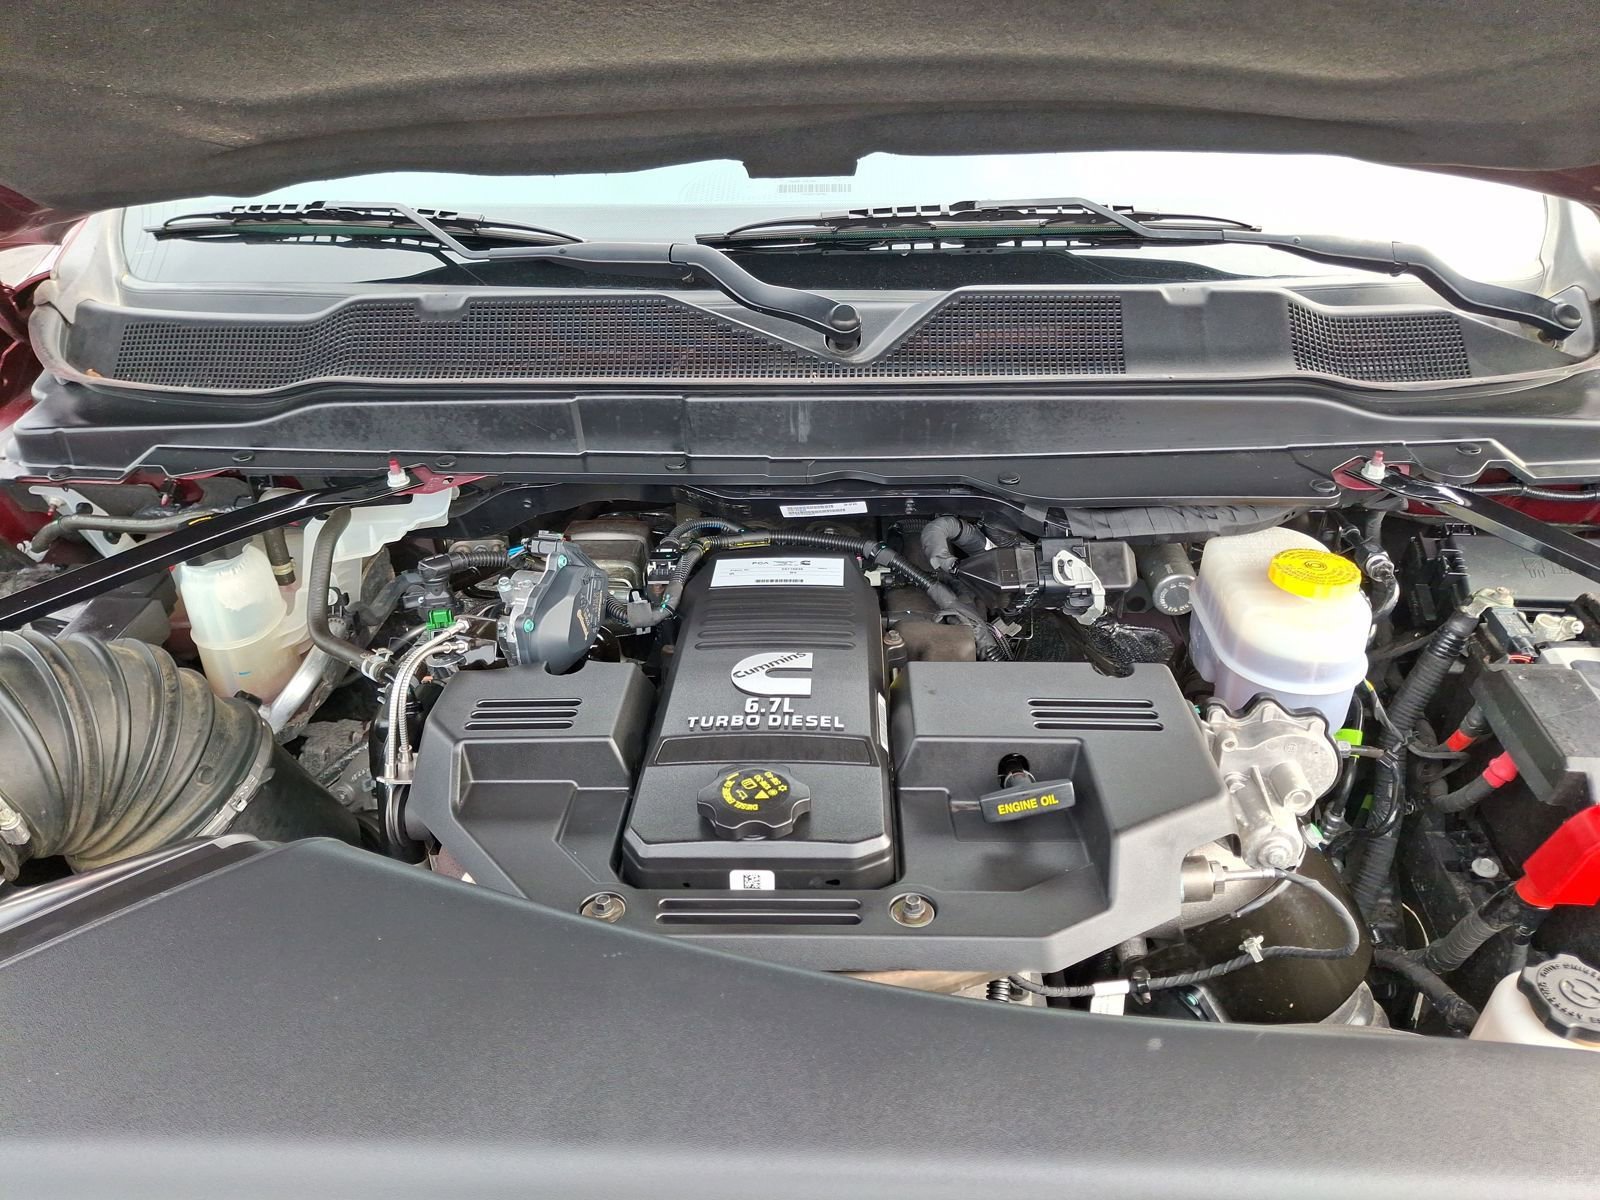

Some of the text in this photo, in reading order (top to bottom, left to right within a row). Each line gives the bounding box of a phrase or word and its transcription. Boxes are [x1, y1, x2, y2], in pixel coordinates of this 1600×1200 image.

[732, 652, 807, 679] Cummins
[744, 698, 794, 714] 6.7L
[687, 715, 845, 730] TURBO DIESEL
[998, 794, 1058, 814] ENGINE OIL
